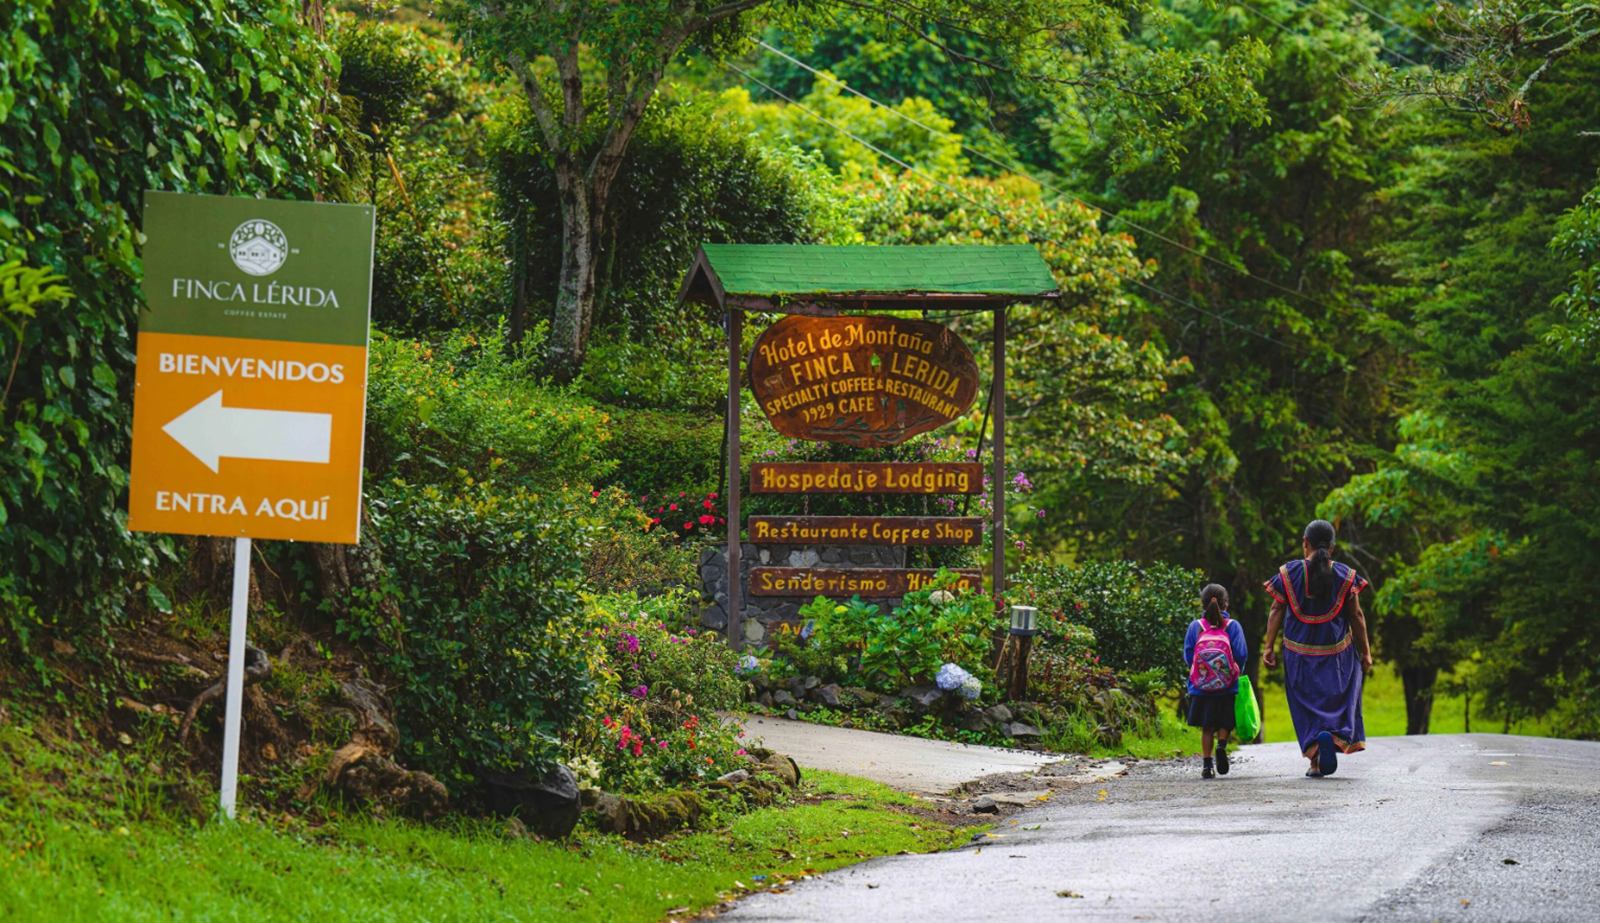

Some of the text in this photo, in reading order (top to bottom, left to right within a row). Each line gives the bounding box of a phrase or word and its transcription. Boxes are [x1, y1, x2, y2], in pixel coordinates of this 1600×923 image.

[172, 278, 339, 308] FINCA LÉRIDA
[224, 309, 287, 319] COFFEE ESTATE
[759, 323, 934, 366] Hotel de Montaña
[159, 352, 345, 384] BIENVENIDOS
[790, 352, 961, 399] FINCA LERIDA
[766, 382, 830, 417] SPECIALTY
[831, 377, 876, 394] COFFEE
[885, 379, 960, 420] RESTAURANT
[802, 396, 875, 424] 1929 CAFE
[760, 466, 969, 493] Hospedaje Lodging
[155, 491, 330, 521] ENTRA AQUÍ
[755, 520, 974, 543] Restaurante Coffee Shop
[762, 572, 888, 591] Senderismo
